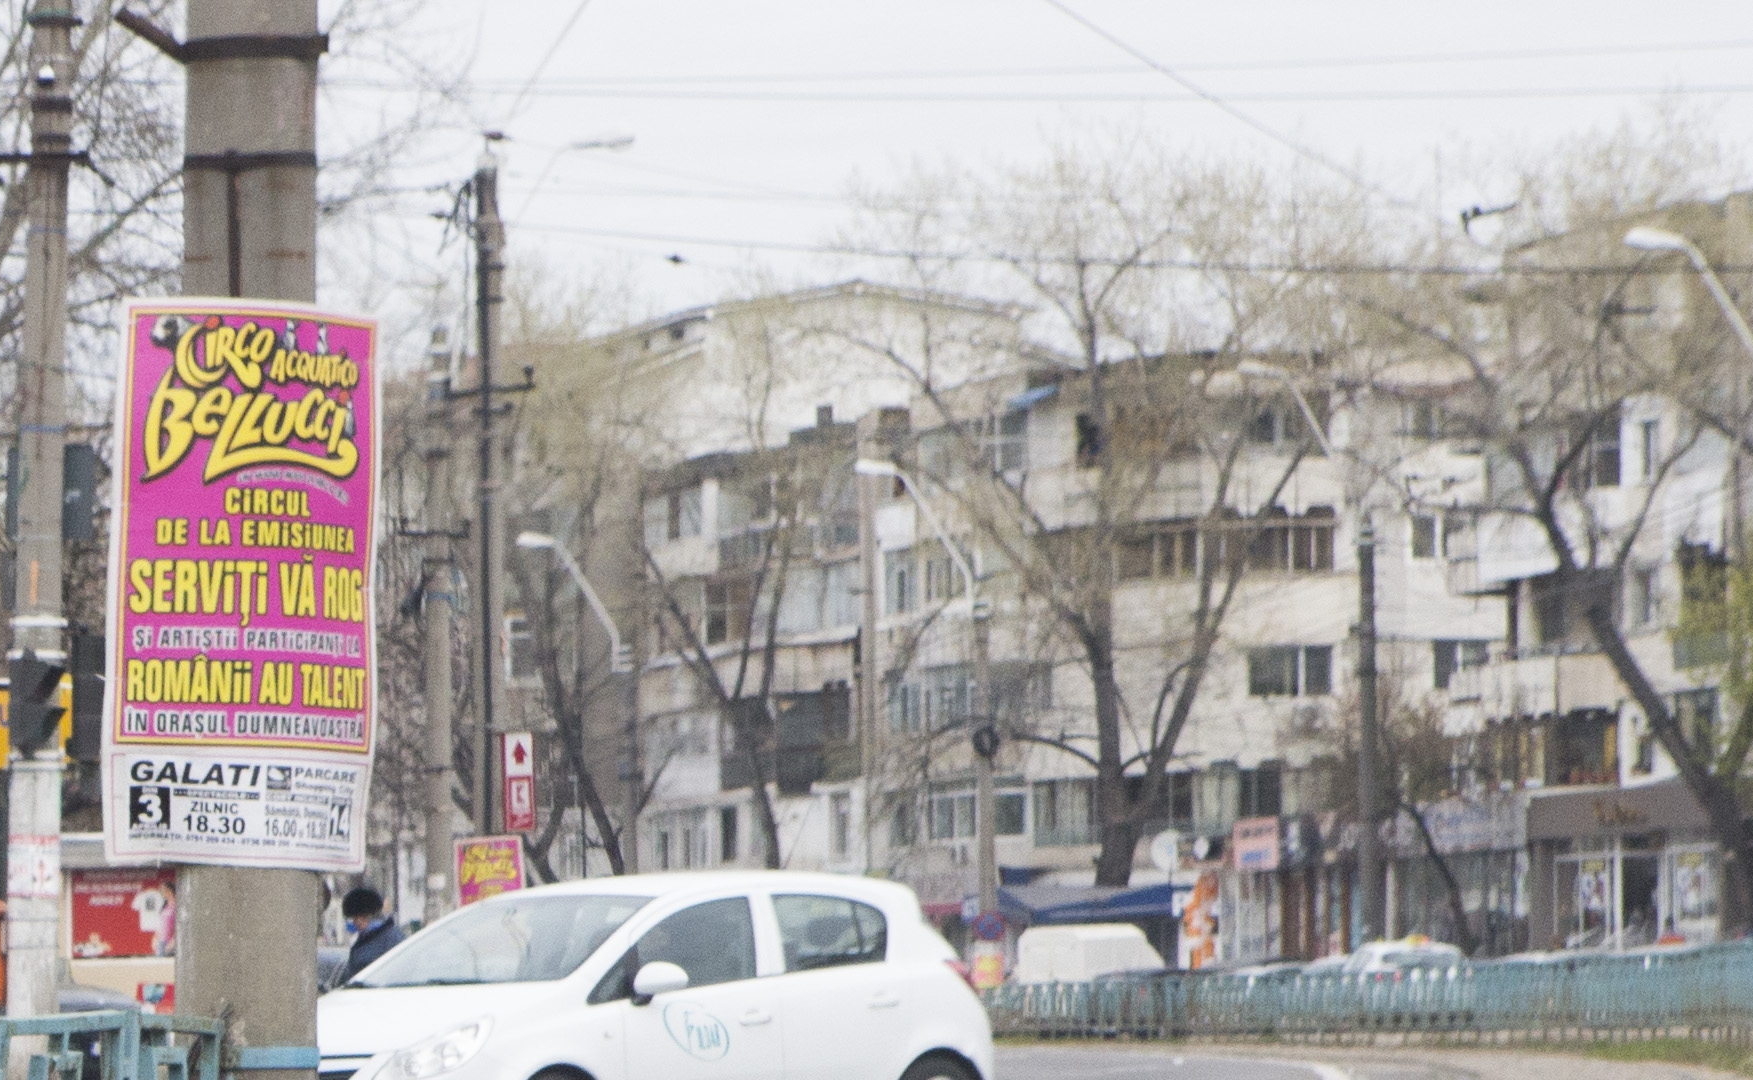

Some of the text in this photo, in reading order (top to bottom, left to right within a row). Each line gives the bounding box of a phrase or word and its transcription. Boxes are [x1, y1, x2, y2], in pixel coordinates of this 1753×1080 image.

[224, 487, 311, 518] CiRCUL
[155, 517, 355, 554] DE LA EMiSiUNEA
[278, 552, 317, 618] VĂ
[323, 564, 364, 623] ROG
[348, 636, 361, 656] LA
[126, 652, 366, 710] ROMÂNii AU TALENT
[130, 760, 262, 786] GALATI
[294, 767, 357, 784] PARCARE
[137, 793, 163, 824] 3
[190, 800, 239, 815] ZILNIC
[329, 803, 350, 837] 14
[183, 813, 246, 835] 18.30
[265, 818, 297, 837] 16.00
